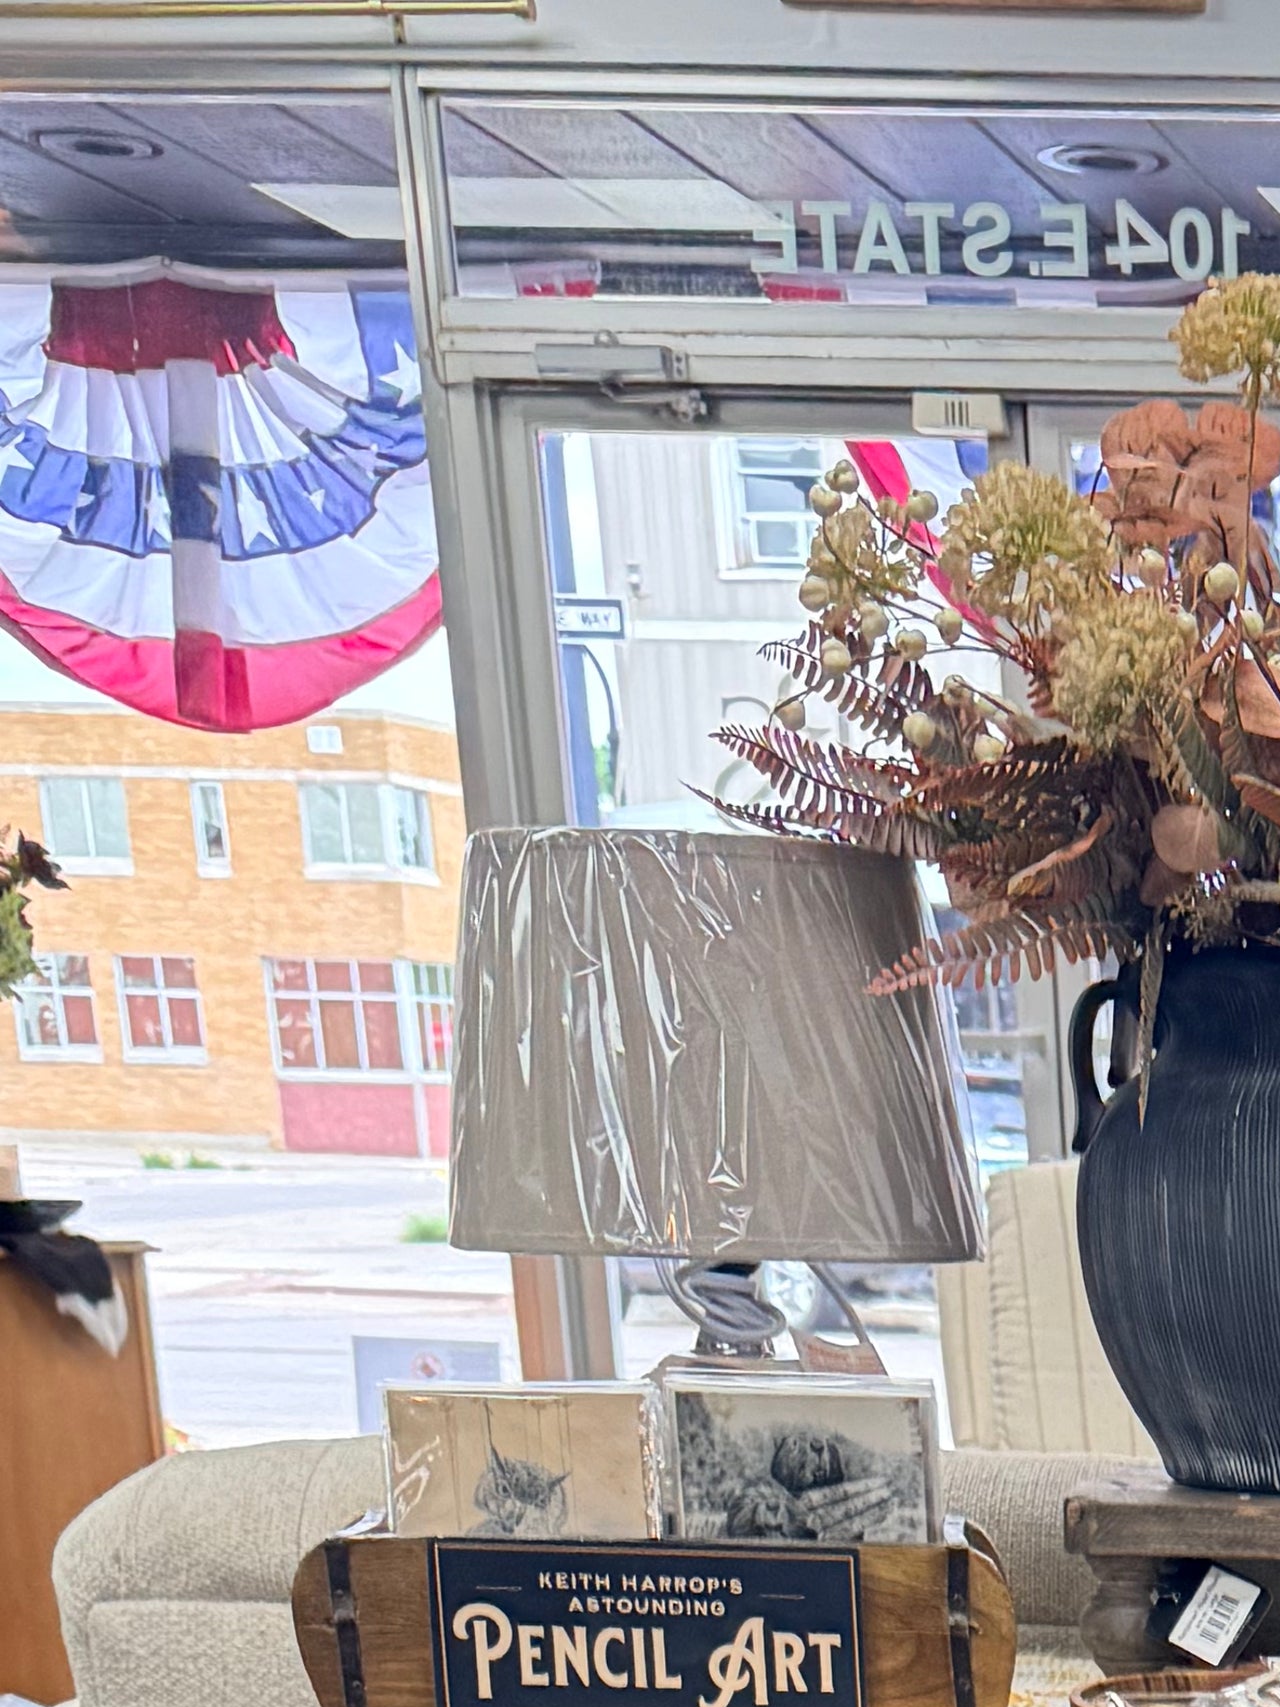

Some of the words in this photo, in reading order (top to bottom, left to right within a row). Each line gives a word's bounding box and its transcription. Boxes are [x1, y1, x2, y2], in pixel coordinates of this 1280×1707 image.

[538, 1570, 611, 1592] KEITH
[620, 1572, 744, 1596] HARROP'S
[567, 1595, 726, 1618] ASTOUNDING
[451, 1601, 684, 1701] PENCIL
